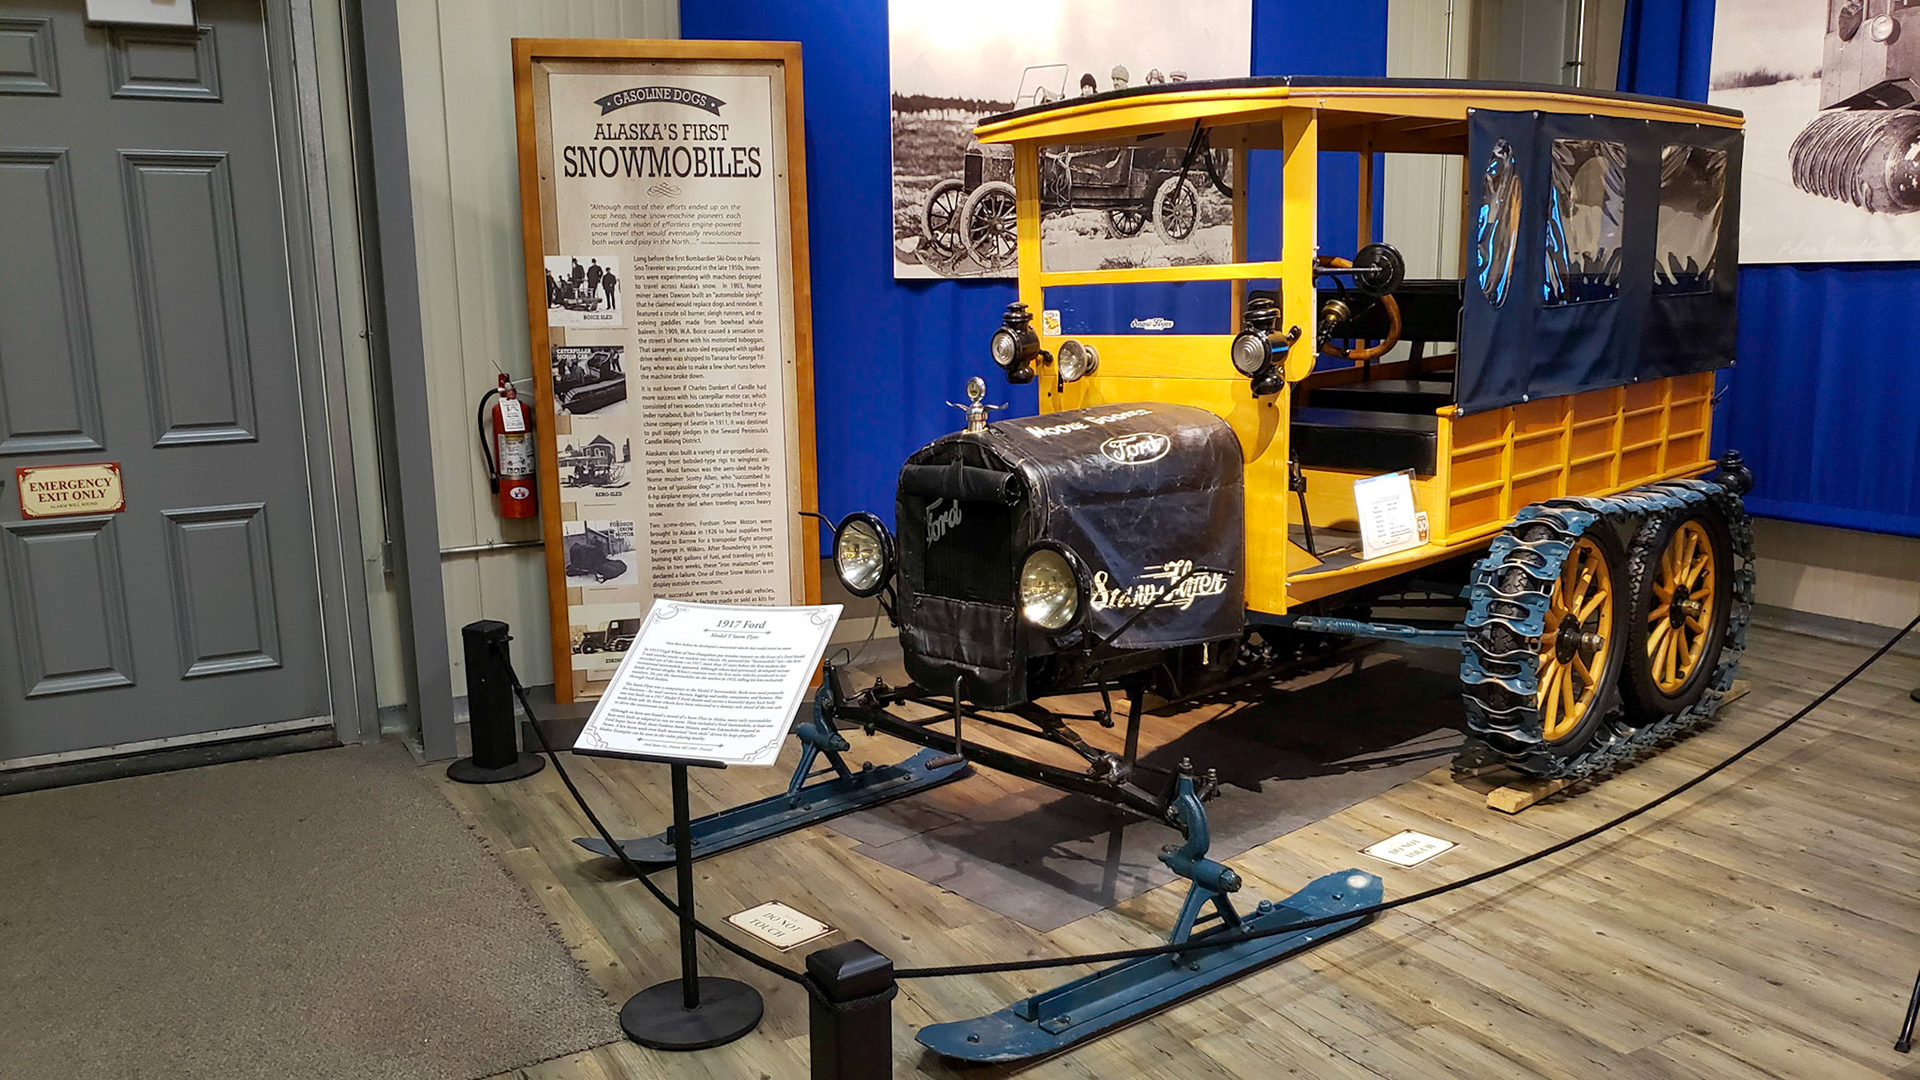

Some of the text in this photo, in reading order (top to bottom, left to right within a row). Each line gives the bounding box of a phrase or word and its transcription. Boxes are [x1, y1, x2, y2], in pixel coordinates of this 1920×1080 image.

[614, 88, 707, 106] GASOLINE DOGS
[594, 123, 729, 140] ALASKA'S FIRST
[564, 146, 762, 178] SNOWMOBILES
[697, 212, 723, 220] pioneers
[692, 220, 741, 229] engine-powered
[668, 230, 700, 238] eventually
[638, 238, 651, 246] play
[663, 438, 681, 446] Mining
[1108, 436, 1165, 460] Ford
[29, 477, 112, 492] EMERGENCY
[38, 489, 107, 503] EXIT ONLY
[926, 498, 962, 548] Ford
[650, 530, 670, 538] brought
[738, 527, 759, 536] supplies
[711, 536, 736, 545] transpolar
[738, 535, 751, 544] flight
[753, 535, 772, 543] attempt
[650, 548, 657, 556] by
[659, 547, 677, 555] George
[722, 544, 750, 553] floundering
[651, 556, 671, 564] burning
[683, 554, 701, 563] gallons
[732, 552, 754, 561] traveling
[755, 552, 765, 560] only
[653, 581, 670, 589] display
[717, 620, 767, 629] 1917 Ford
[763, 912, 803, 932] DO NOT
[750, 919, 786, 938] TOUCH
